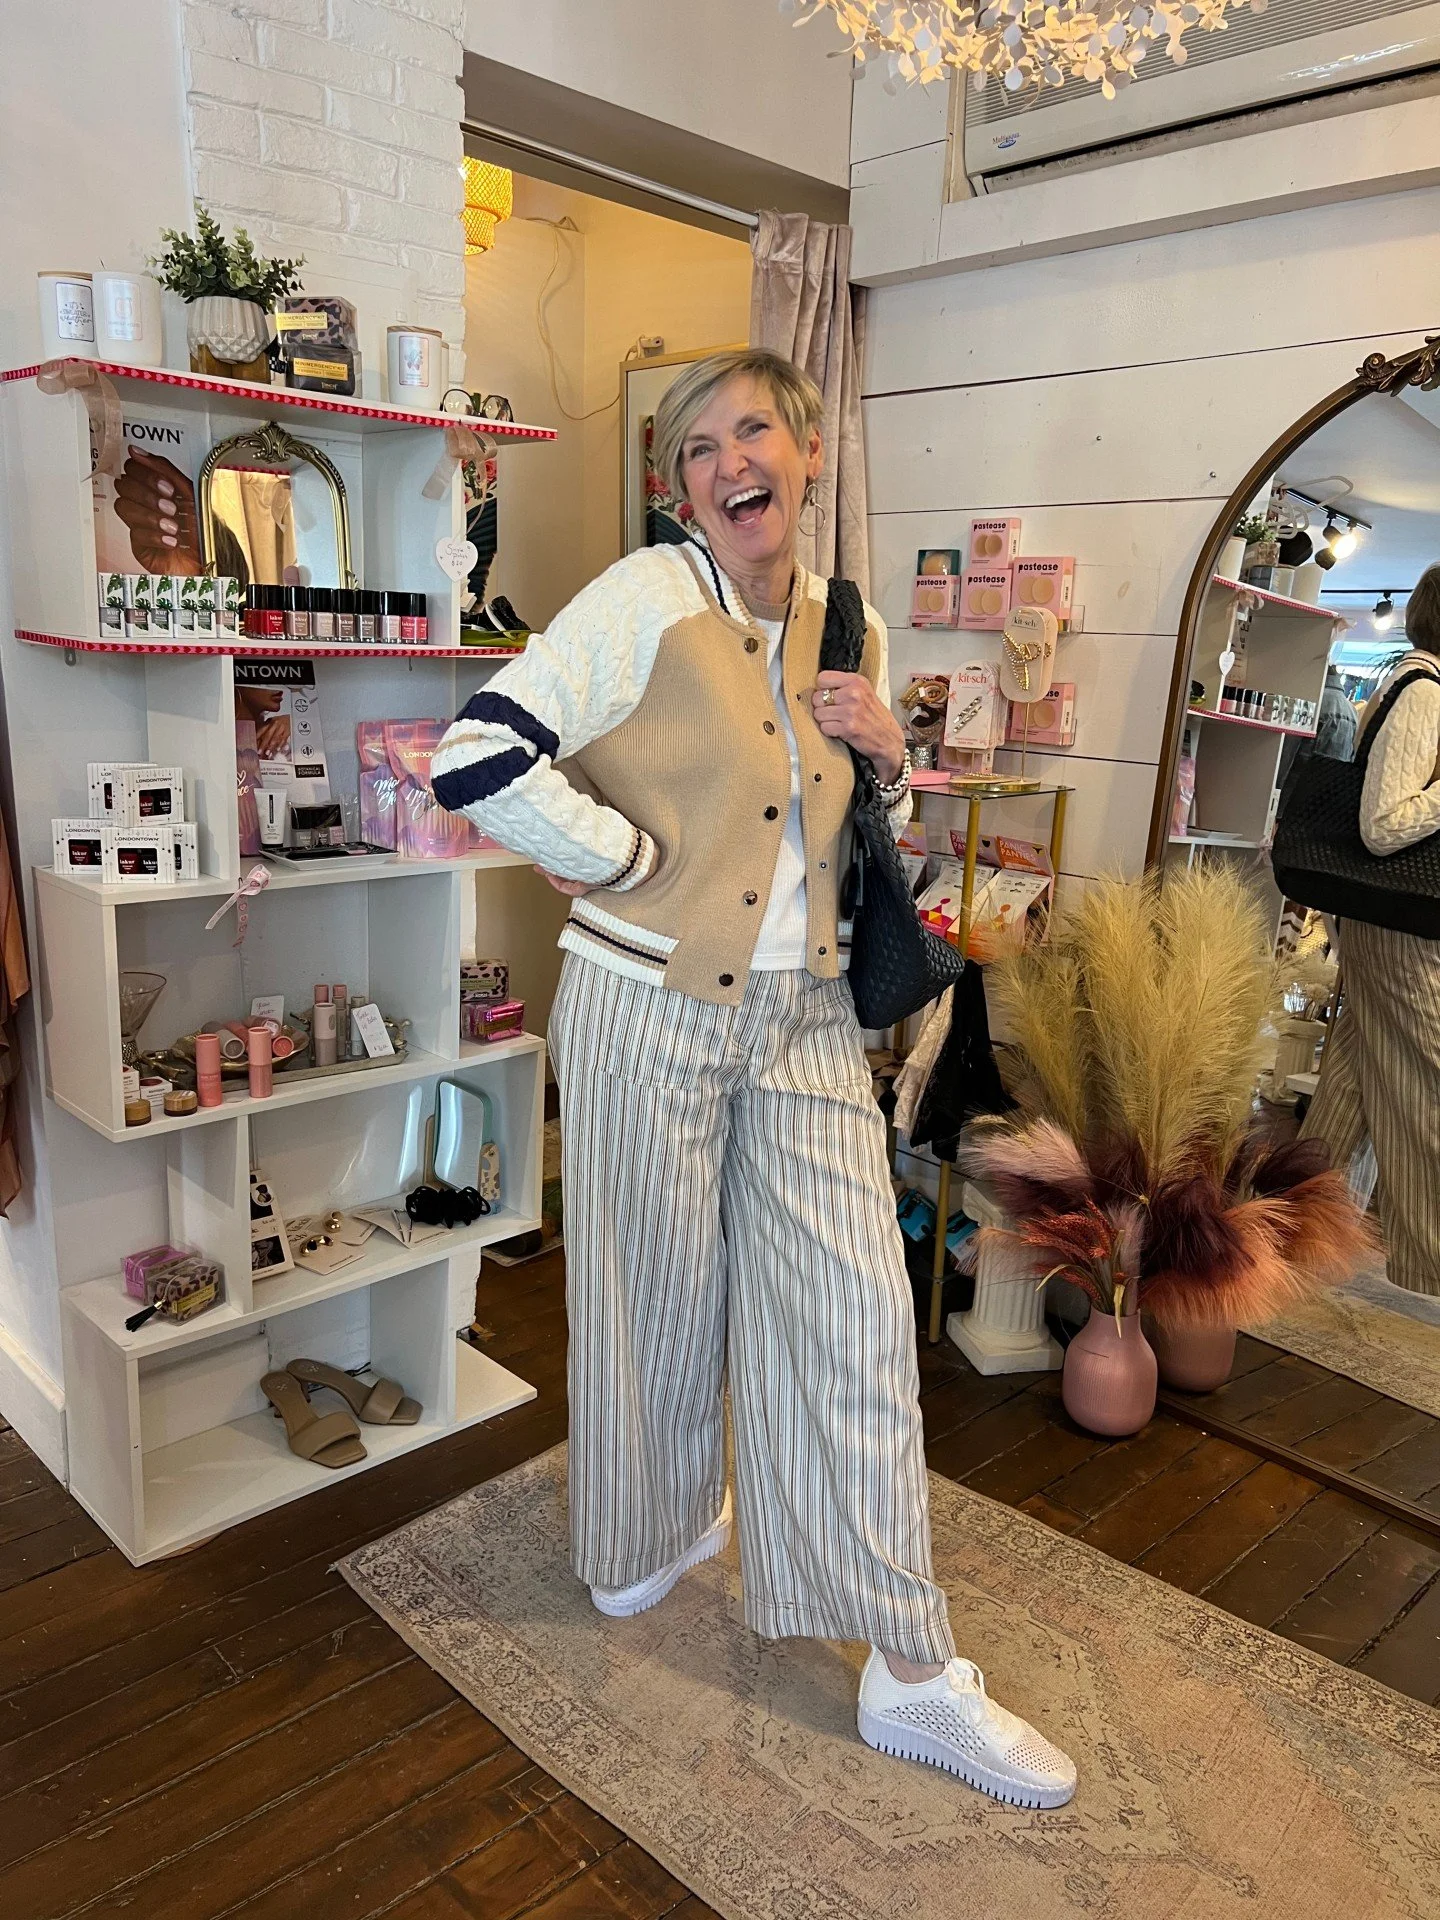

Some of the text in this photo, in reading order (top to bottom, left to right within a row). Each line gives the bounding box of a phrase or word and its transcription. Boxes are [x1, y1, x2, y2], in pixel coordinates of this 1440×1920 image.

[973, 521, 1007, 532] pastease
[1018, 562, 1059, 574] pastease
[916, 578, 947, 588] pastease
[967, 575, 1006, 586] pastease
[999, 840, 1025, 850] PANIC
[1001, 848, 1036, 862] PANTIES
